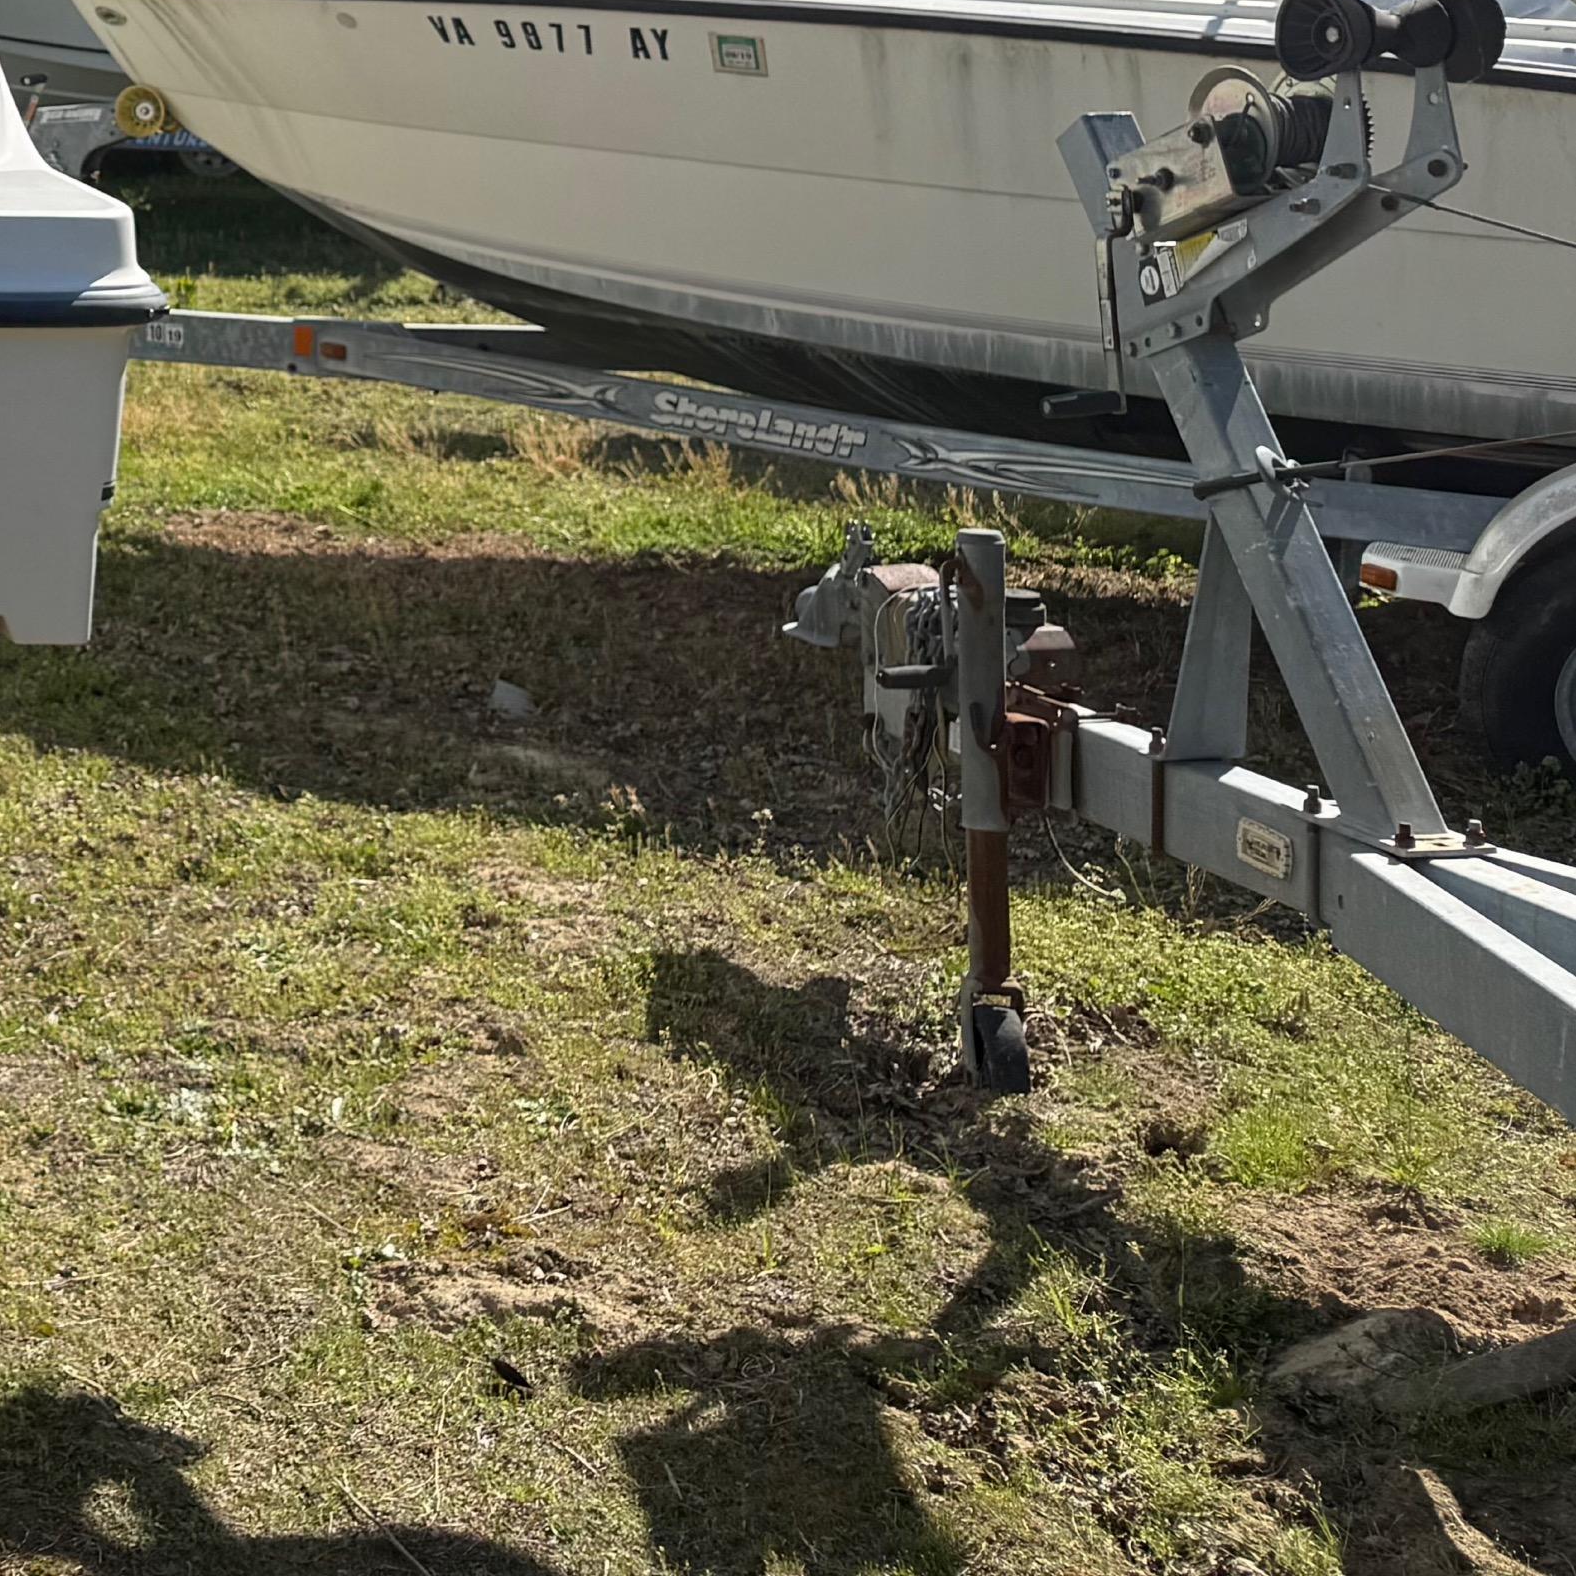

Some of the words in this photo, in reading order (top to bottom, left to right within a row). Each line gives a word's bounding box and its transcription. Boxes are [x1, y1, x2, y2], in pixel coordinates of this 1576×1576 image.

[427, 15, 476, 46] VA
[494, 20, 593, 55] 9877
[629, 27, 669, 61] AY
